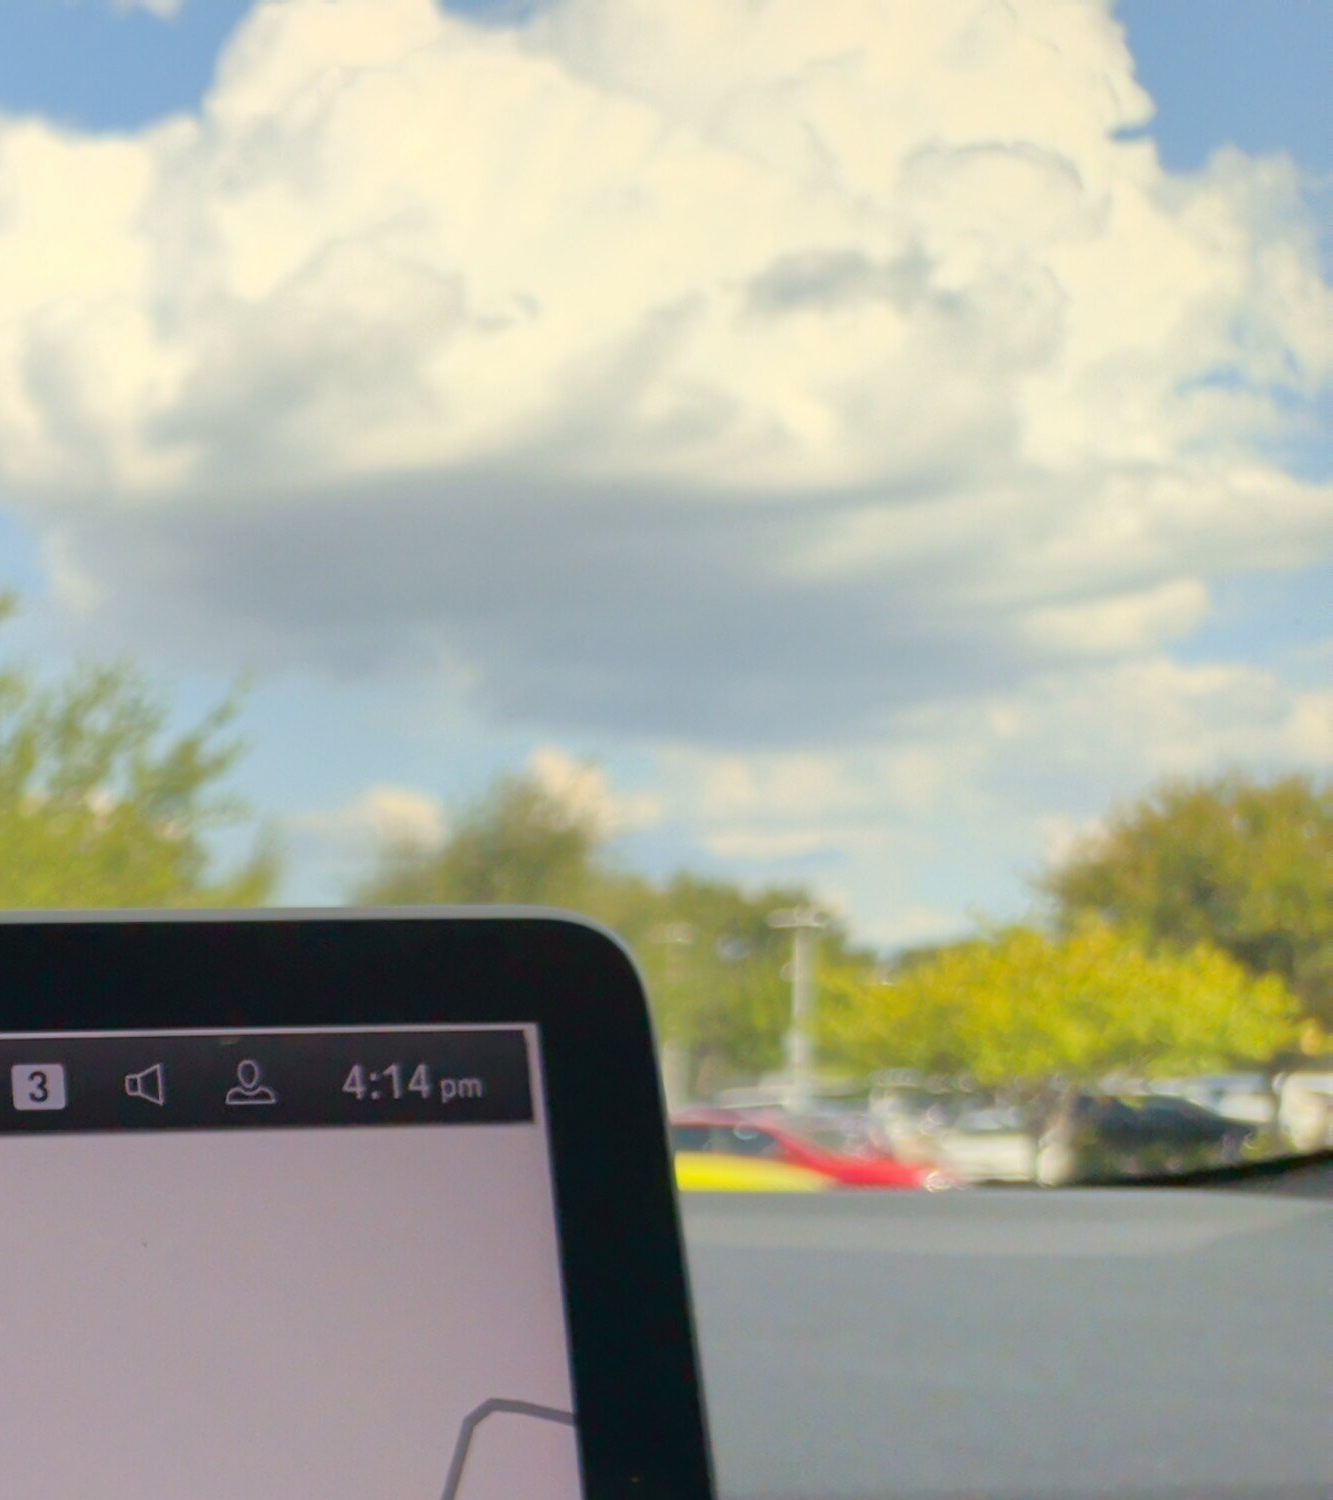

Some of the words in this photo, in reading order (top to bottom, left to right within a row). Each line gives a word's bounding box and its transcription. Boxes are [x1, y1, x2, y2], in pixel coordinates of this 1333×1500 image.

[28, 1071, 49, 1103] 3
[341, 1063, 431, 1101] 4:14
[440, 1074, 483, 1104] pm
